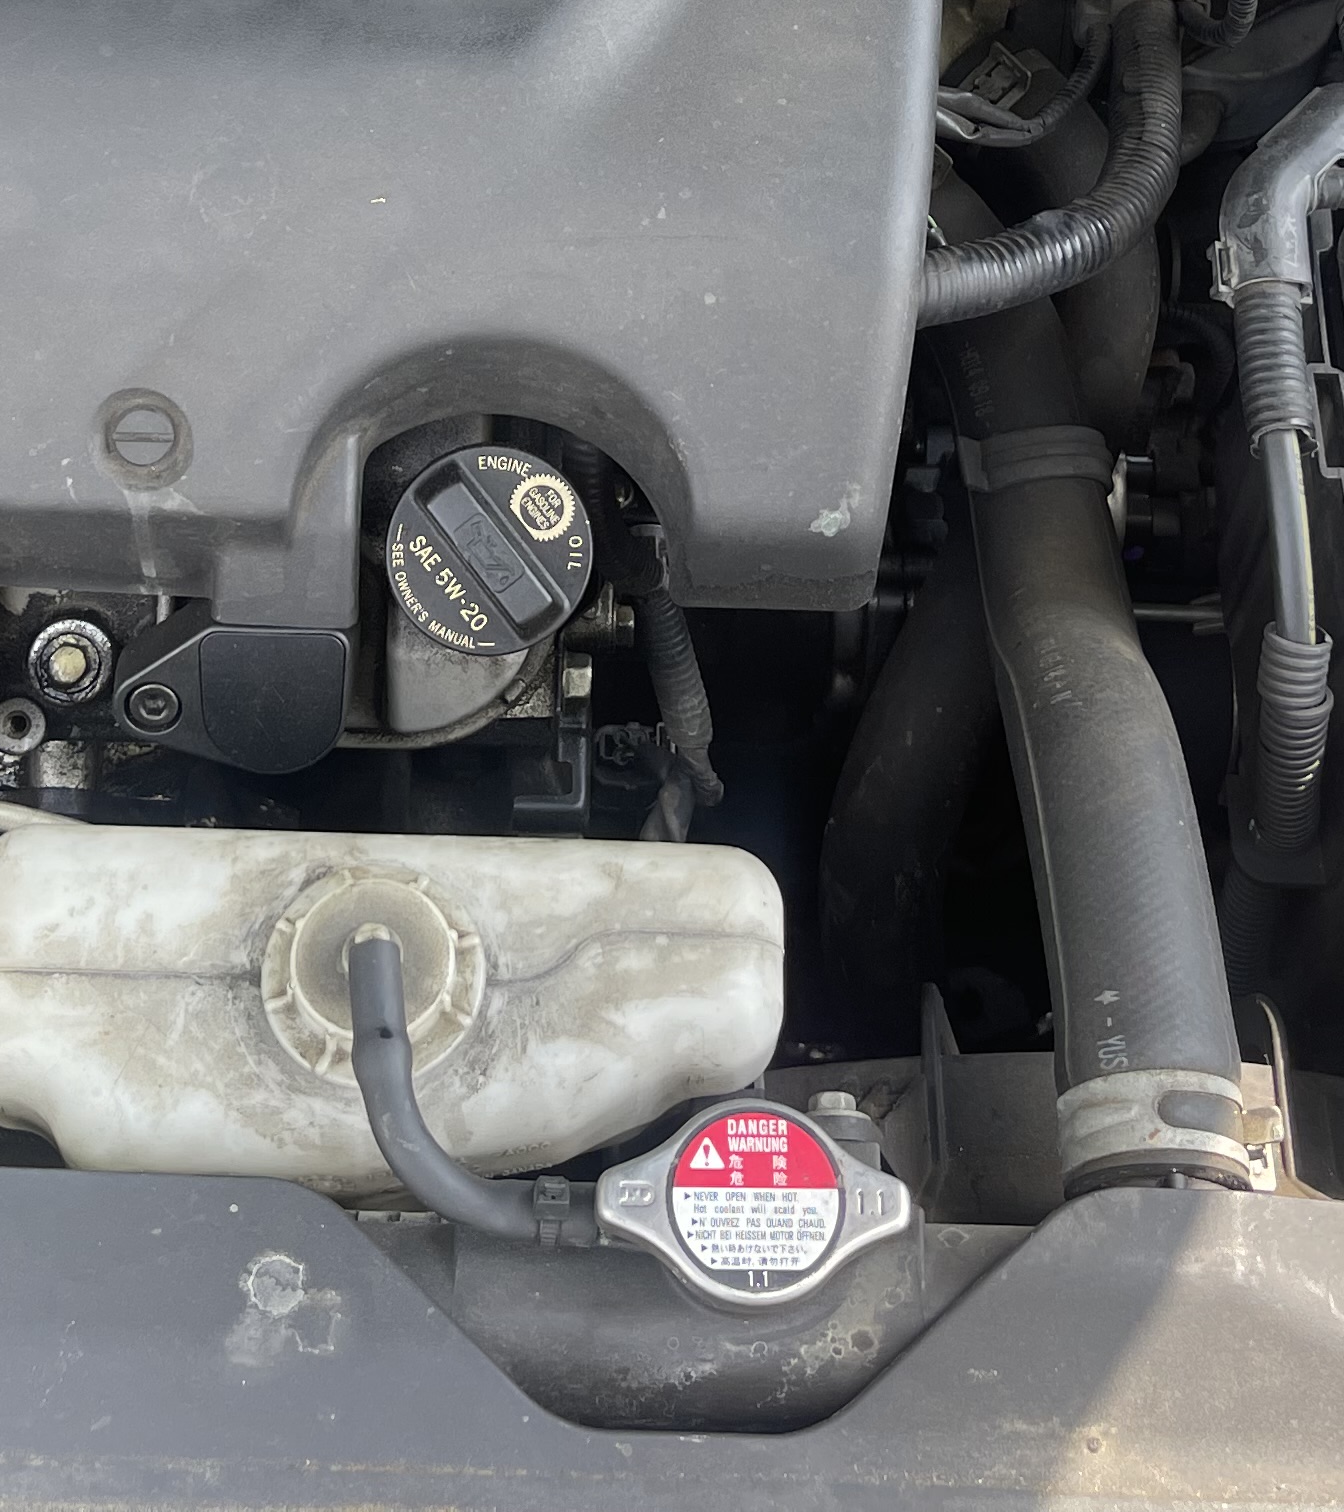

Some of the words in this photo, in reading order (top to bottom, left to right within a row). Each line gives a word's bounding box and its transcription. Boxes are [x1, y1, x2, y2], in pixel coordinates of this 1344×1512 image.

[478, 455, 532, 477] ENGINE
[528, 487, 561, 527] GASOLINE
[544, 488, 562, 509] FOR
[520, 495, 551, 531] ENGINES
[391, 543, 405, 568] SEE
[567, 535, 584, 570] OIL
[408, 535, 443, 572] SAE
[435, 567, 490, 632] 5W-20
[394, 571, 430, 623] OWNER'S
[428, 619, 476, 649] MANUAL
[727, 1119, 788, 1135] DANGER
[728, 1136, 788, 1152] WARNUNG
[693, 1191, 719, 1202] NEVER
[725, 1191, 747, 1202] OPEN
[753, 1191, 776, 1202] WHEN
[856, 1189, 885, 1217] 1.1
[693, 1204, 707, 1214] Hot
[714, 1204, 745, 1214] coolant
[751, 1204, 766, 1214] will
[773, 1204, 795, 1214] scald
[710, 1218, 740, 1228] OUVREZ
[746, 1218, 761, 1228] PAS
[766, 1218, 793, 1228] QUAND
[798, 1218, 827, 1229] CHAUD.
[695, 1230, 716, 1240] NICHT
[720, 1230, 732, 1240] BEI
[735, 1230, 766, 1240] HEISSEM
[770, 1231, 794, 1241] MOTOR
[748, 1270, 769, 1288] 1.1
